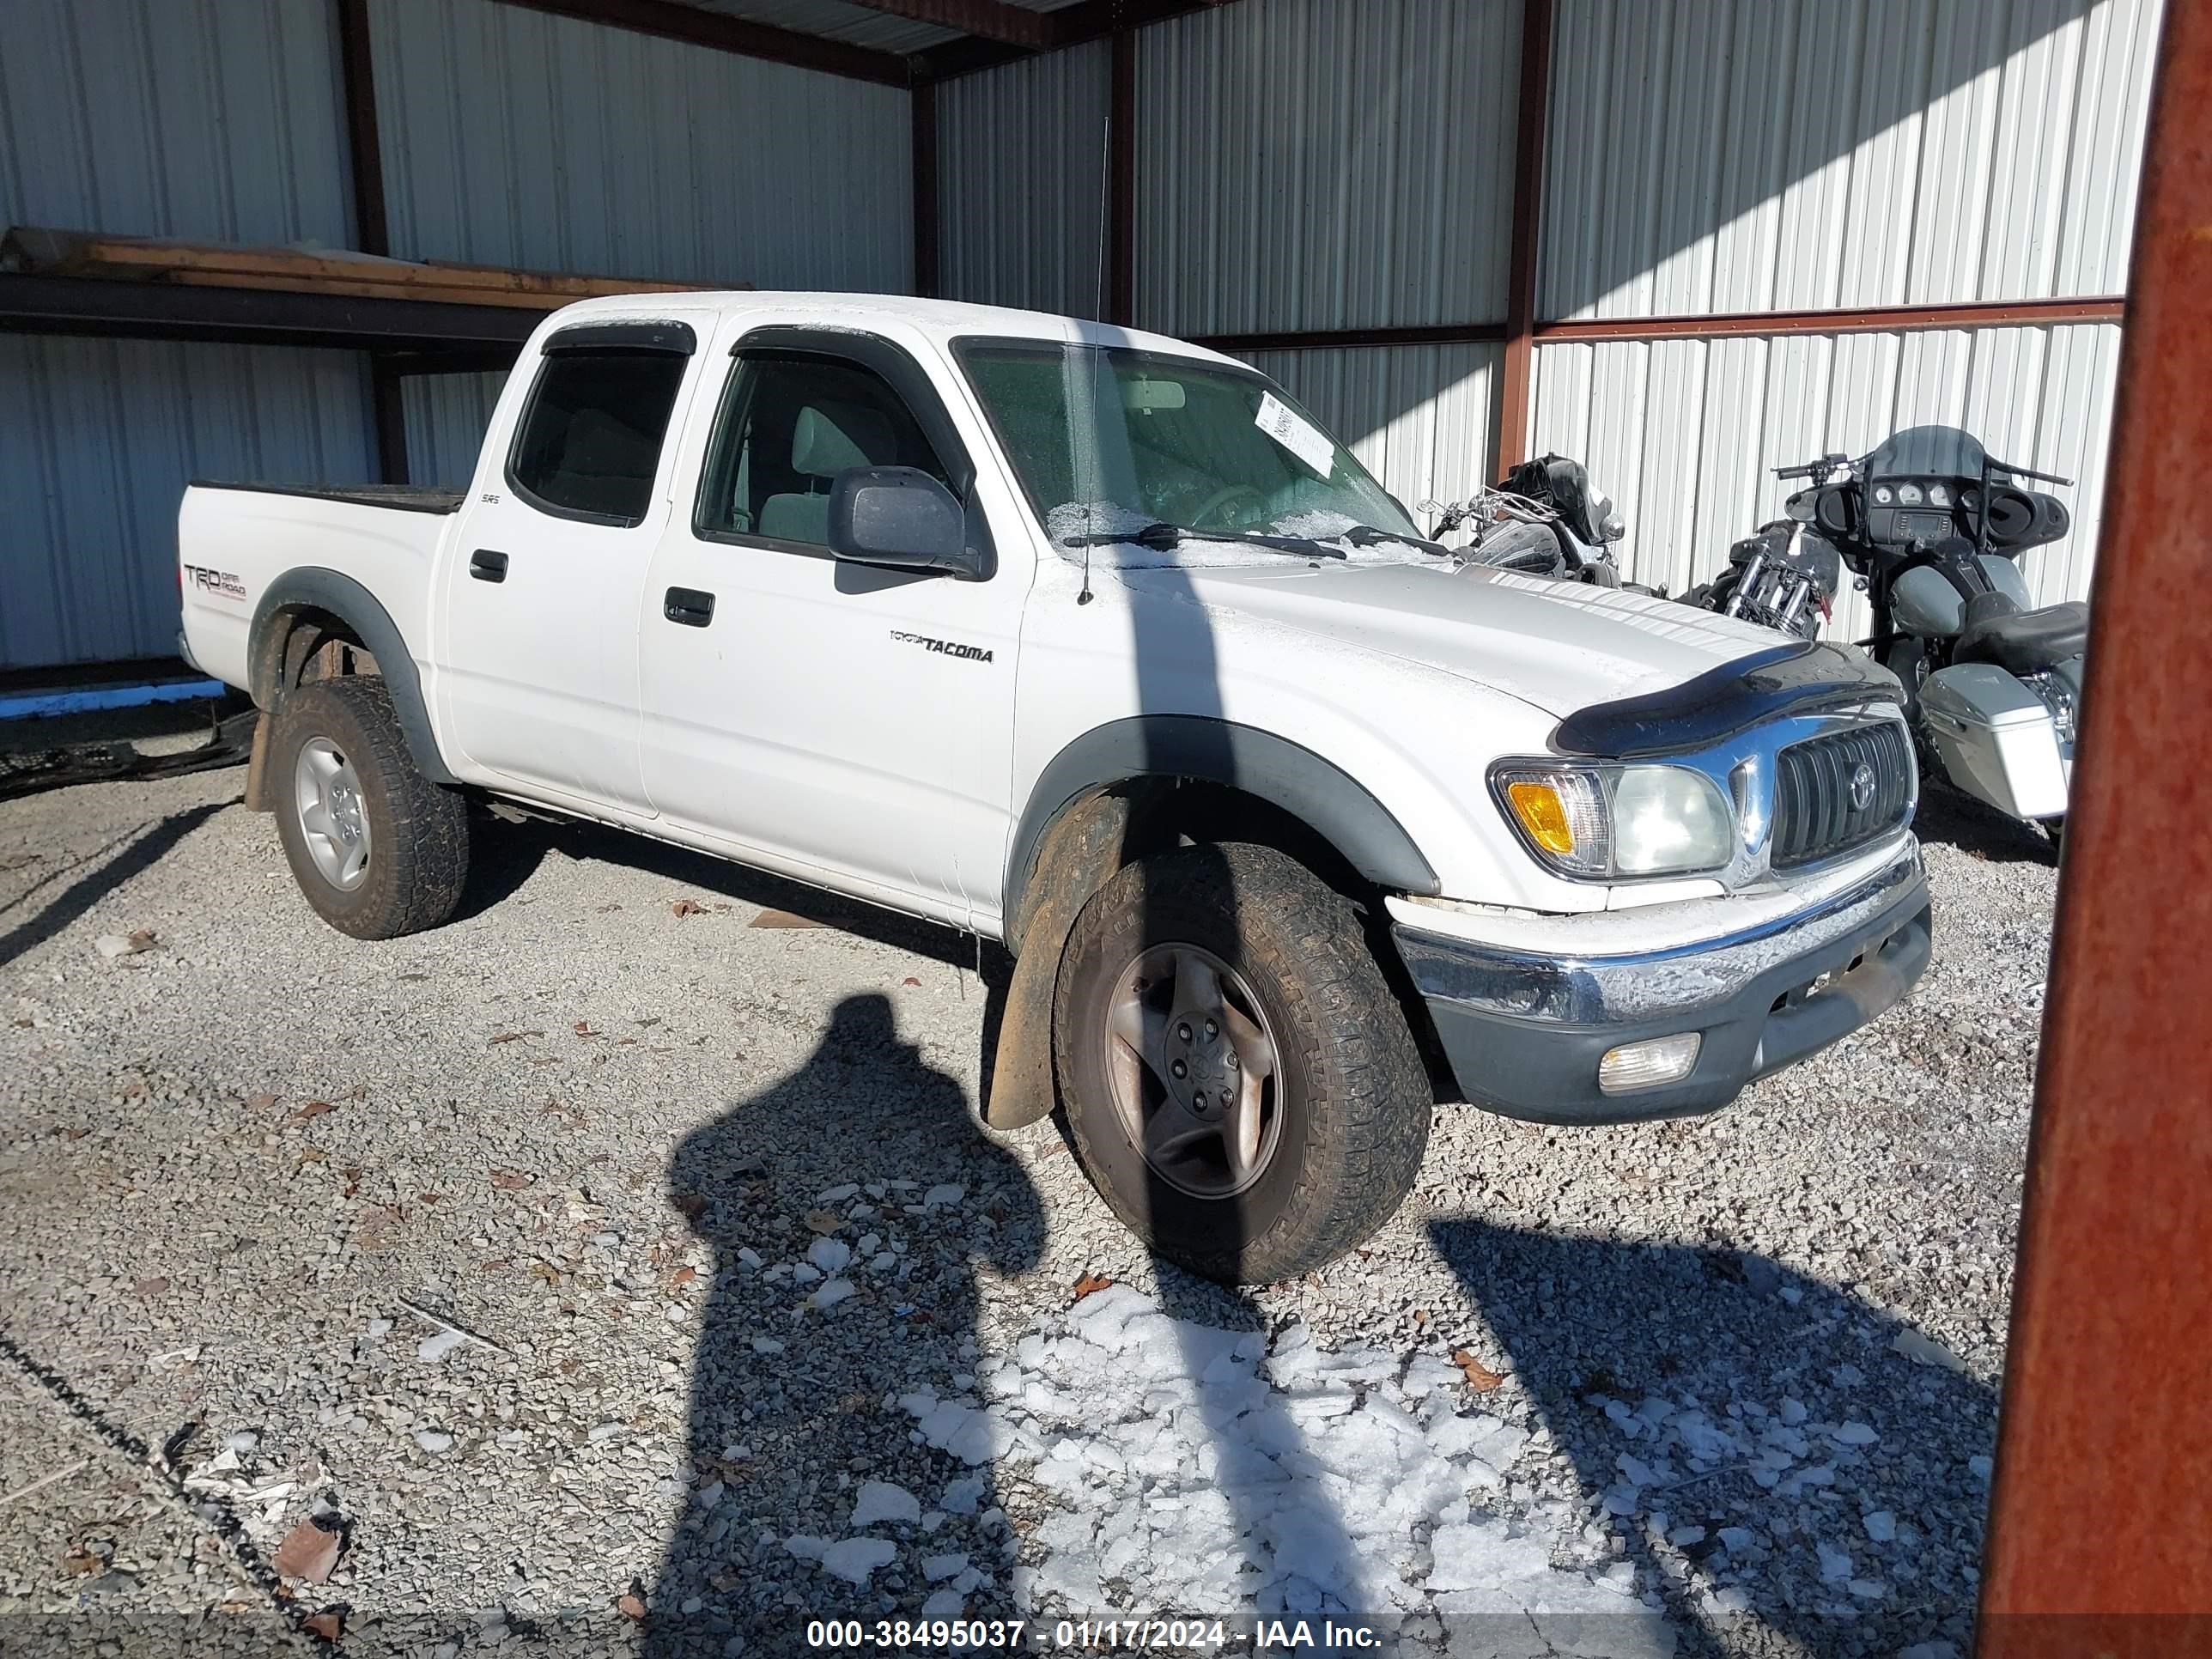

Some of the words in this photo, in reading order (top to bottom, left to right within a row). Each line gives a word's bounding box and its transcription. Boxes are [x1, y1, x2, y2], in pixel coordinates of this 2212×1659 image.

[184, 563, 221, 591] TRD
[222, 582, 246, 595] ROAD
[890, 630, 923, 644] TOYOTA
[922, 637, 994, 663] TACOMA
